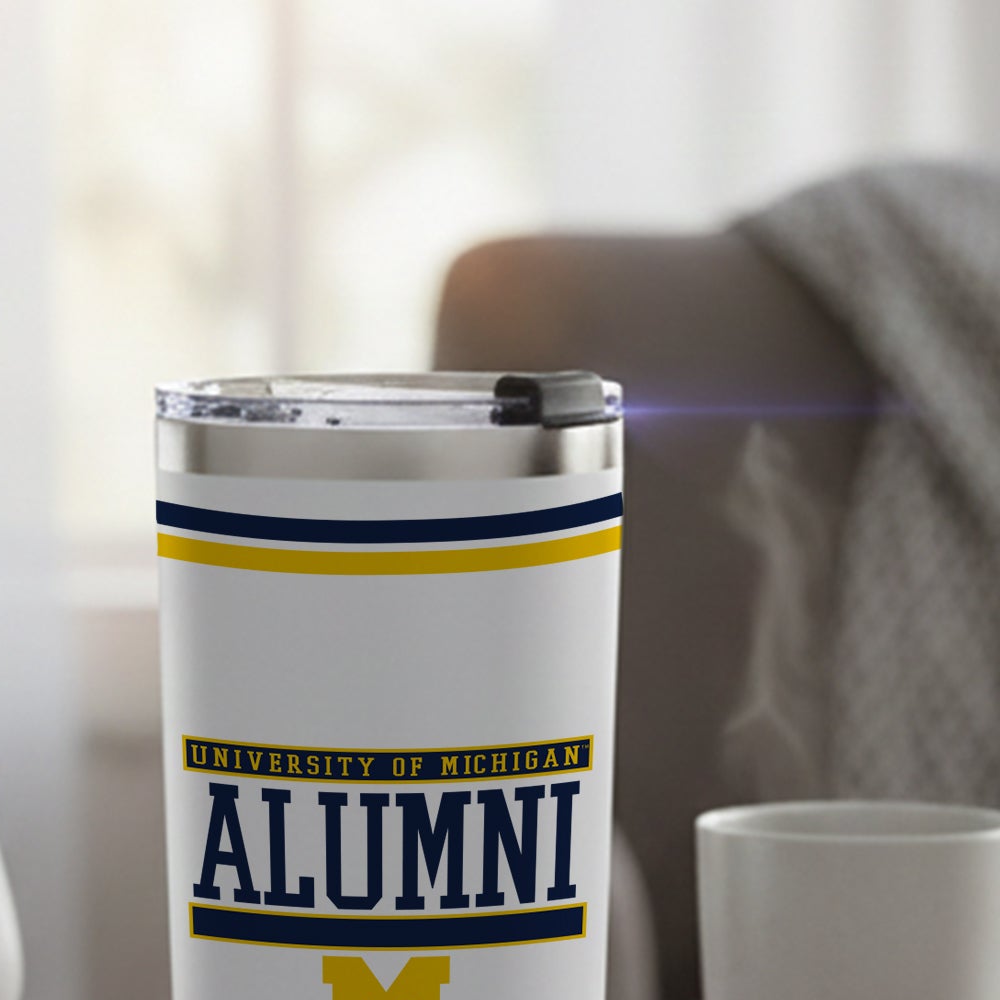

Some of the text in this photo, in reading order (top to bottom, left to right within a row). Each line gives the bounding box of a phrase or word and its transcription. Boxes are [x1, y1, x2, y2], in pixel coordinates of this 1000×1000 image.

[191, 744, 581, 777] UNIVERSITY OF MICHIGAN
[193, 781, 581, 911] ALUMNI
